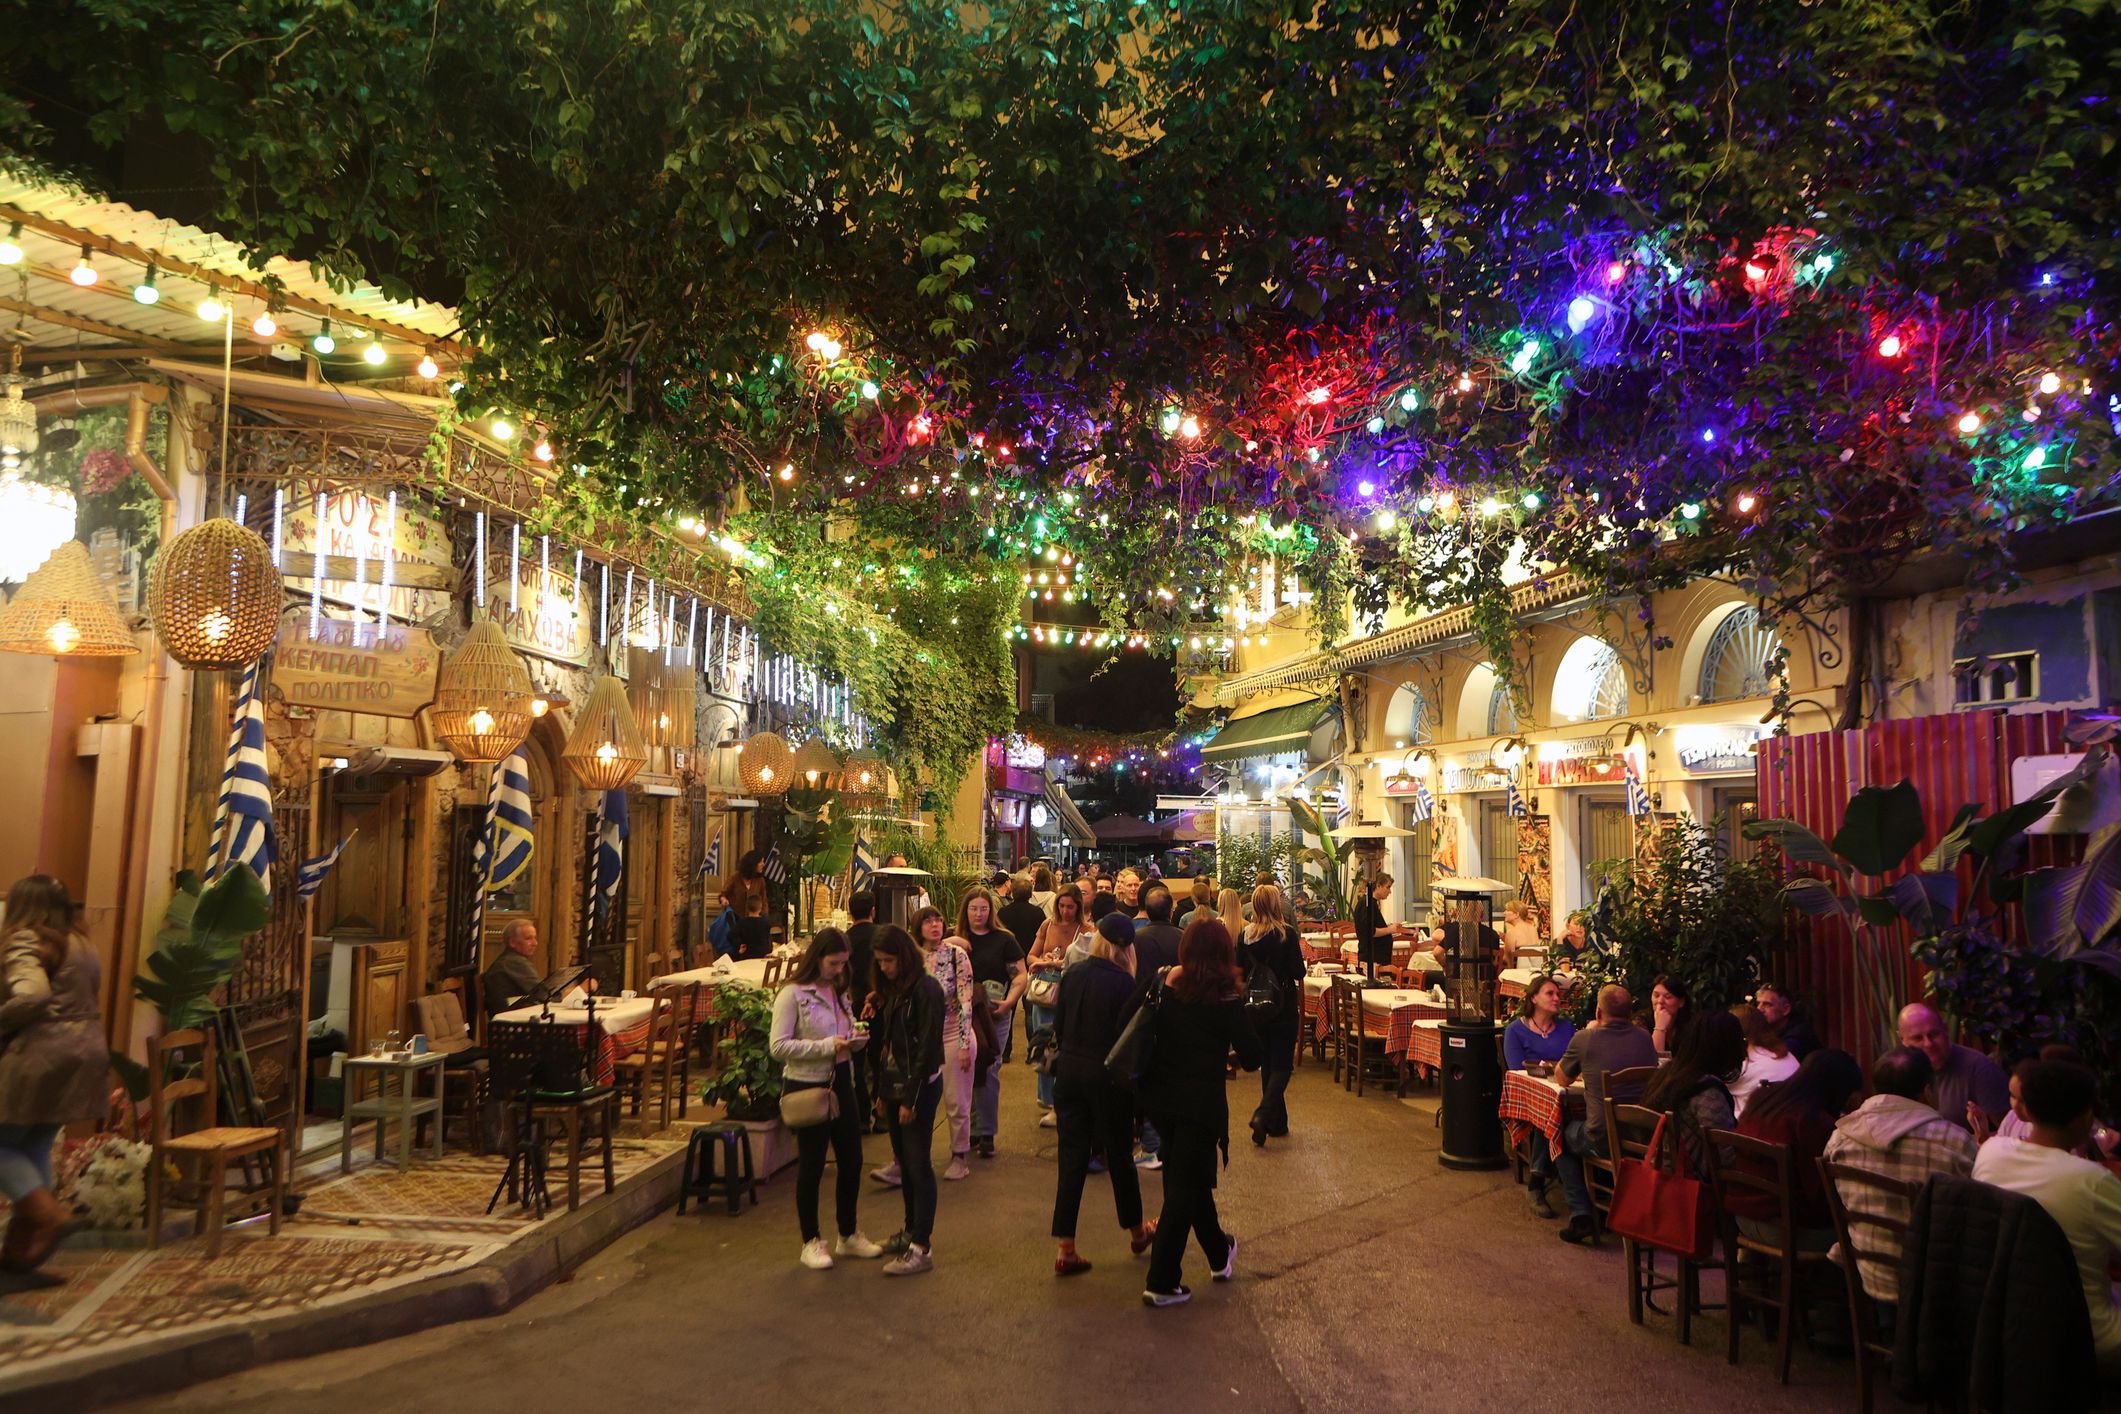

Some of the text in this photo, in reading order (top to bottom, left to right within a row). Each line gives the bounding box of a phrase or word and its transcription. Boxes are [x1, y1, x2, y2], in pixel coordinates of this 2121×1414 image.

[491, 556, 576, 604] ΨΗΟΠΩΛΕΙΟ
[489, 596, 577, 653] ΑΡΑΧΩΒΑ
[279, 648, 378, 677] ΚΕΜΠΑΠ
[292, 681, 392, 701] ΠΟΛΙΤΙΚΟ
[1554, 752, 1640, 785] ΑΡΑΒΑ
